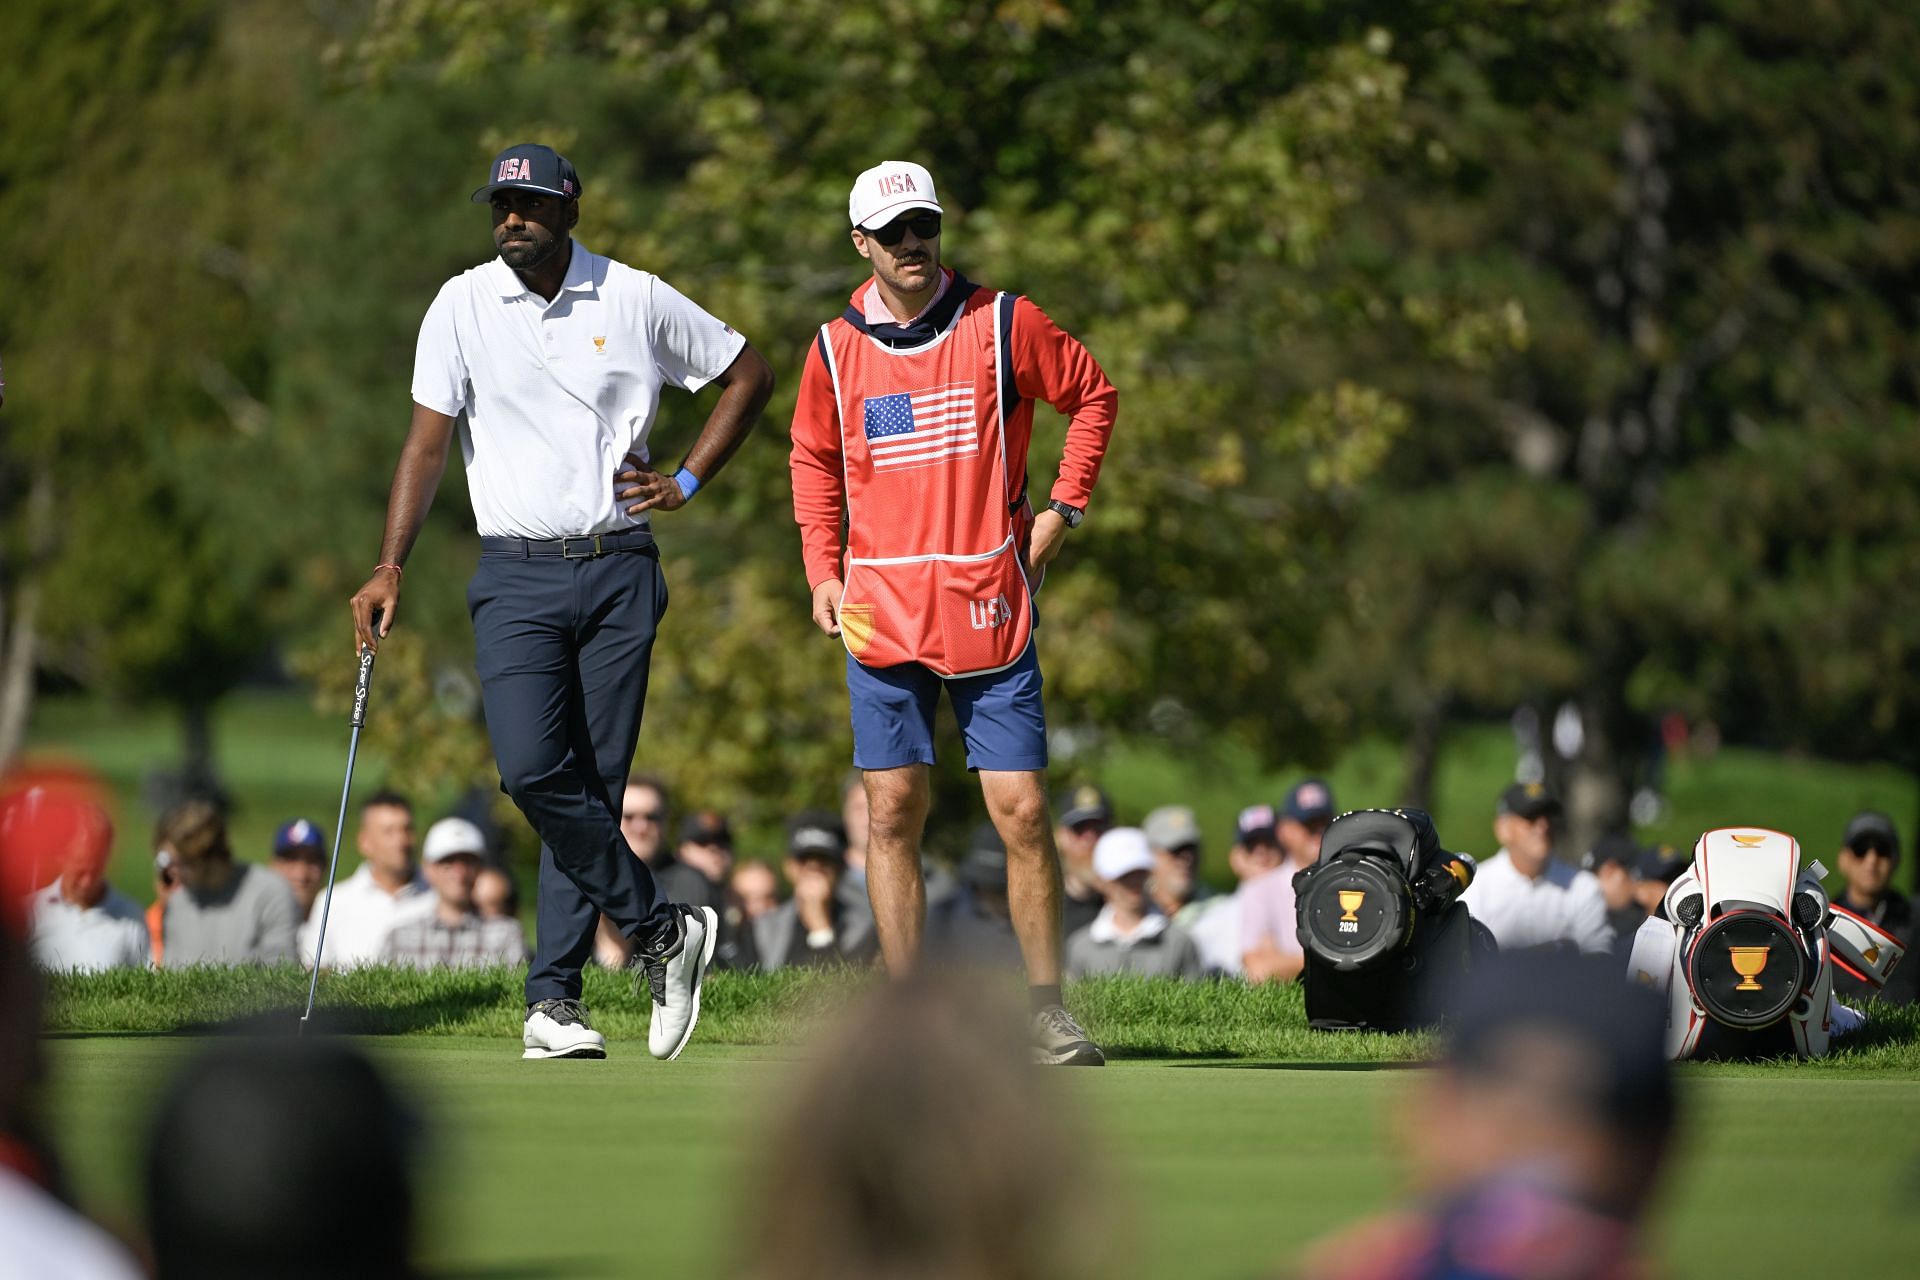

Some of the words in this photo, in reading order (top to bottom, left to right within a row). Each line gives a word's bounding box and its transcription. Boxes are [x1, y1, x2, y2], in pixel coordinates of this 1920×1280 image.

[497, 158, 531, 182] USA
[878, 173, 917, 197] USA
[969, 592, 1012, 630] USA
[1338, 921, 1359, 933] 2024
